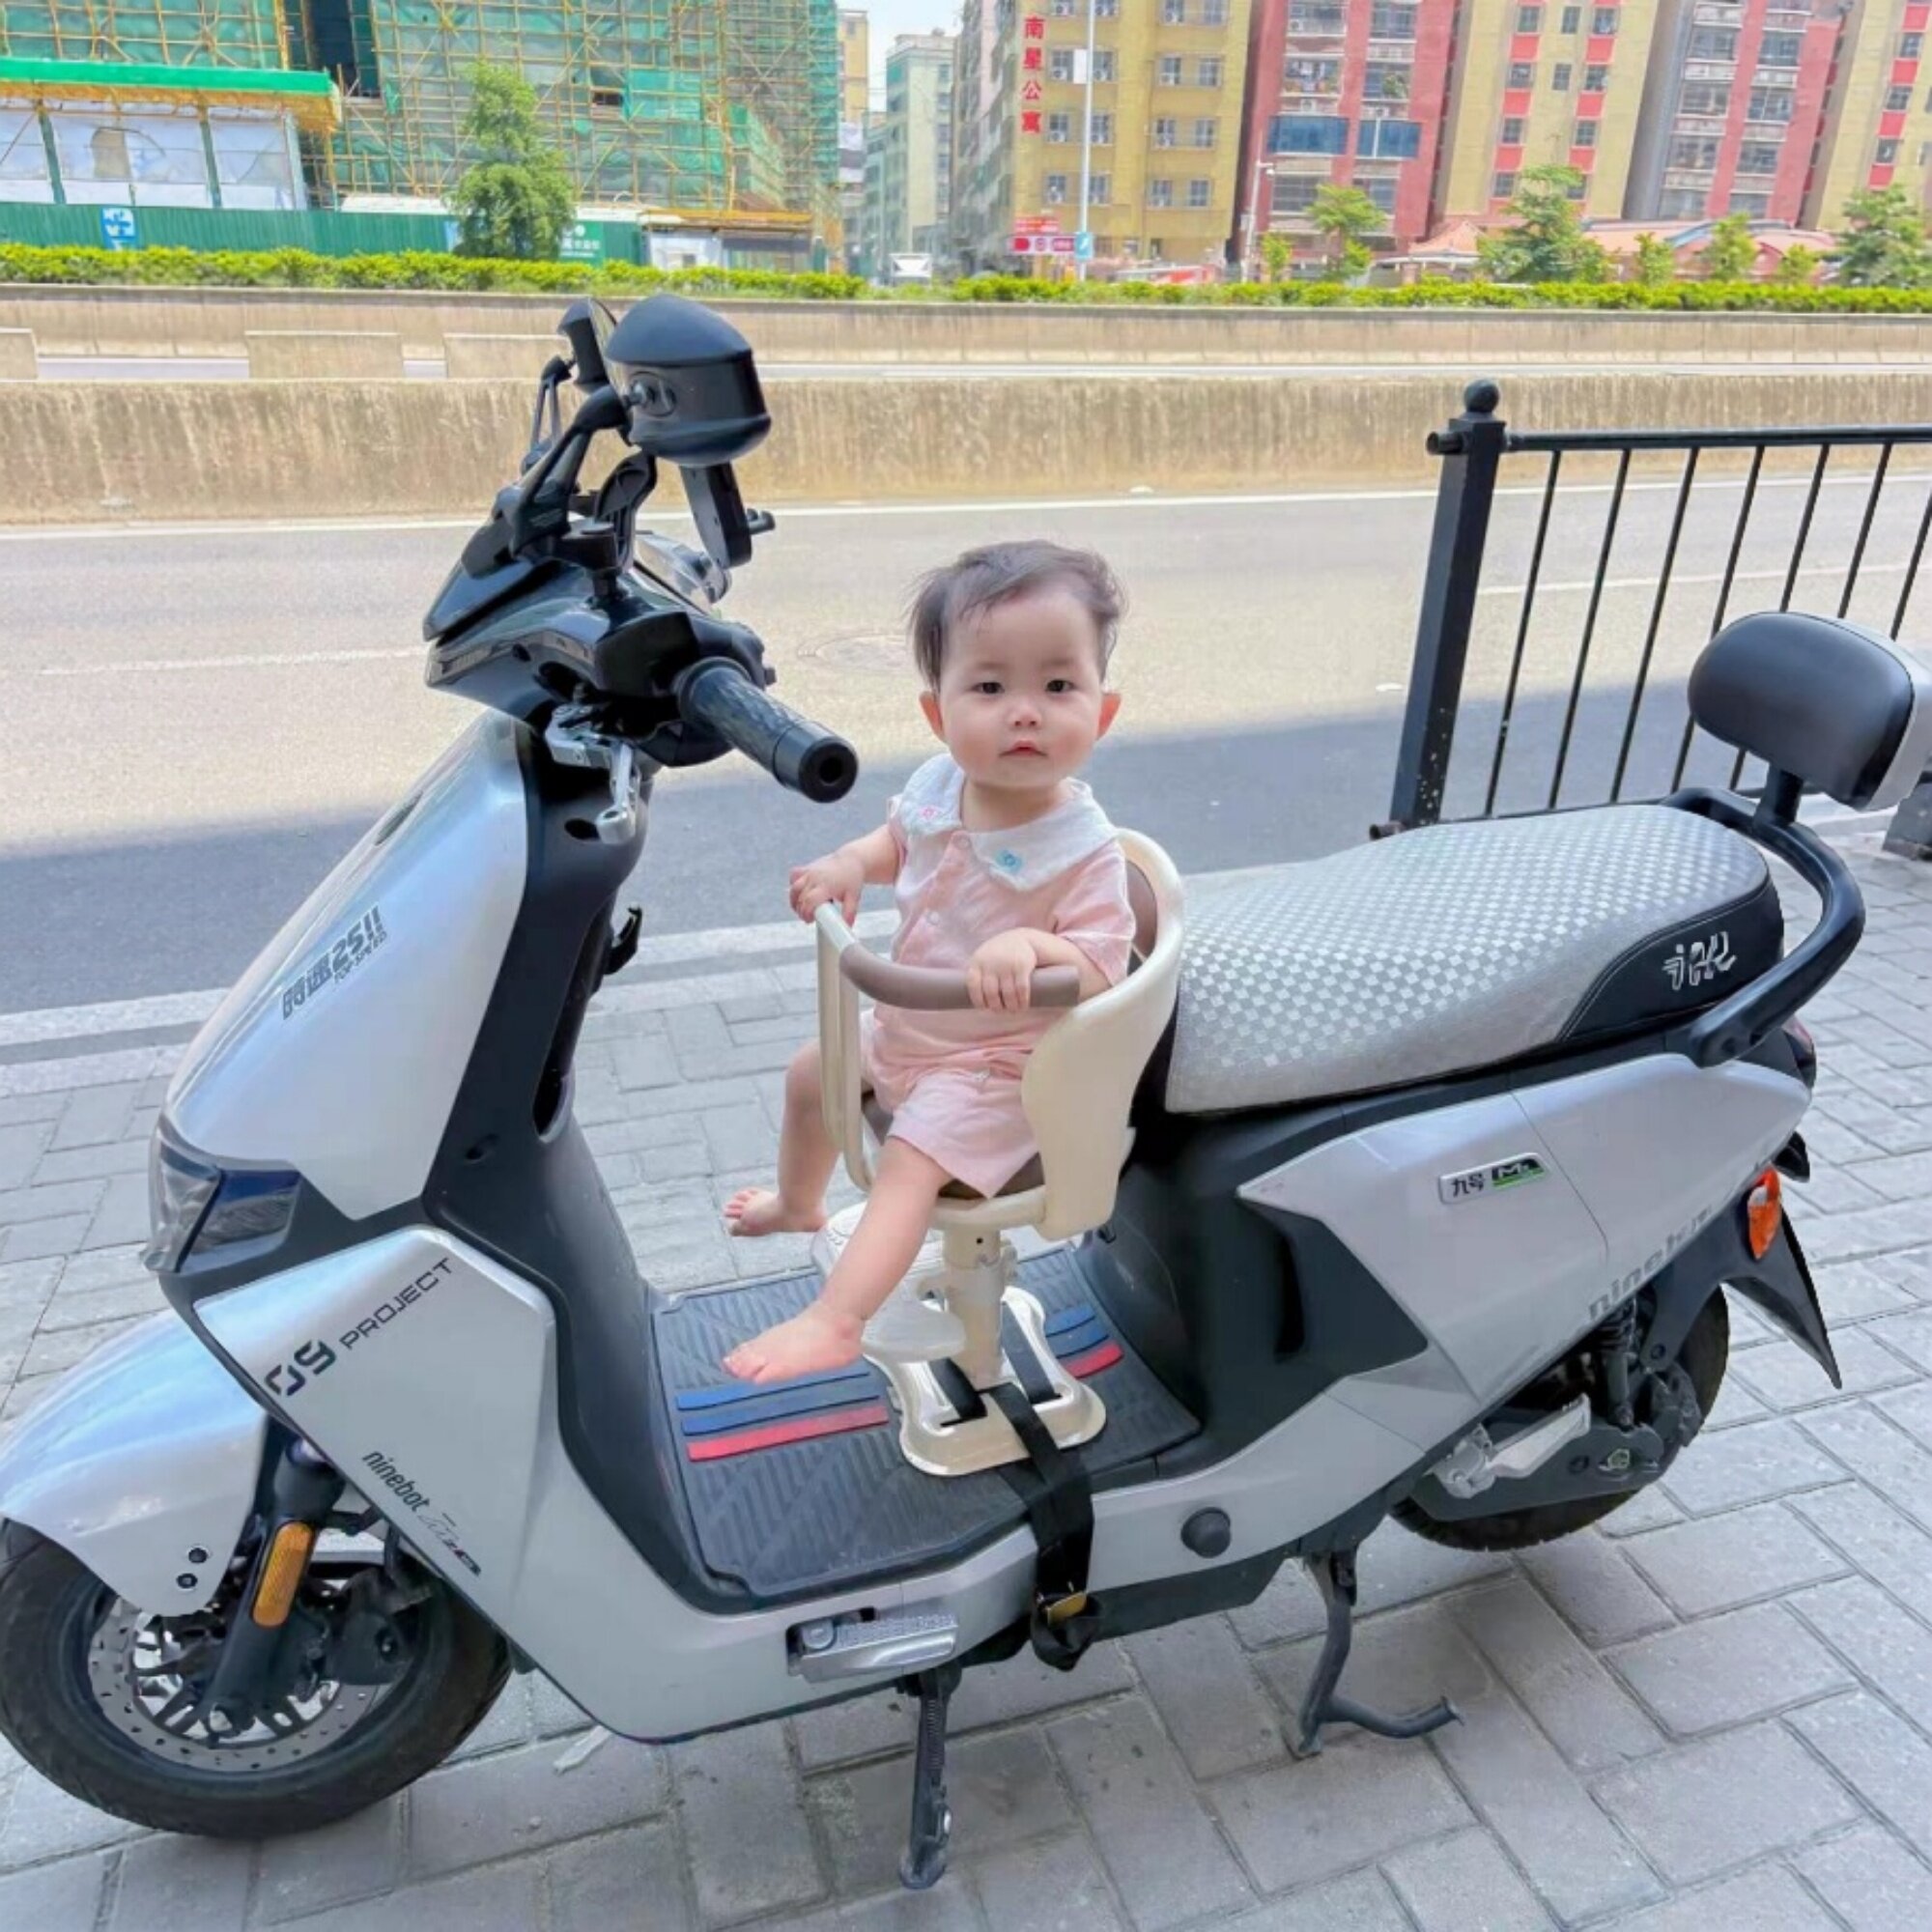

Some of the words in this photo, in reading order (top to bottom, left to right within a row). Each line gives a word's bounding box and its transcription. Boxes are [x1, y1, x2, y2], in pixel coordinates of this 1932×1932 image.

[1022, 14, 1045, 134] 南星公寓
[1451, 1173, 1486, 1198] 九号
[339, 1257, 453, 1350] PROJECT
[362, 1451, 431, 1512] ninebot
